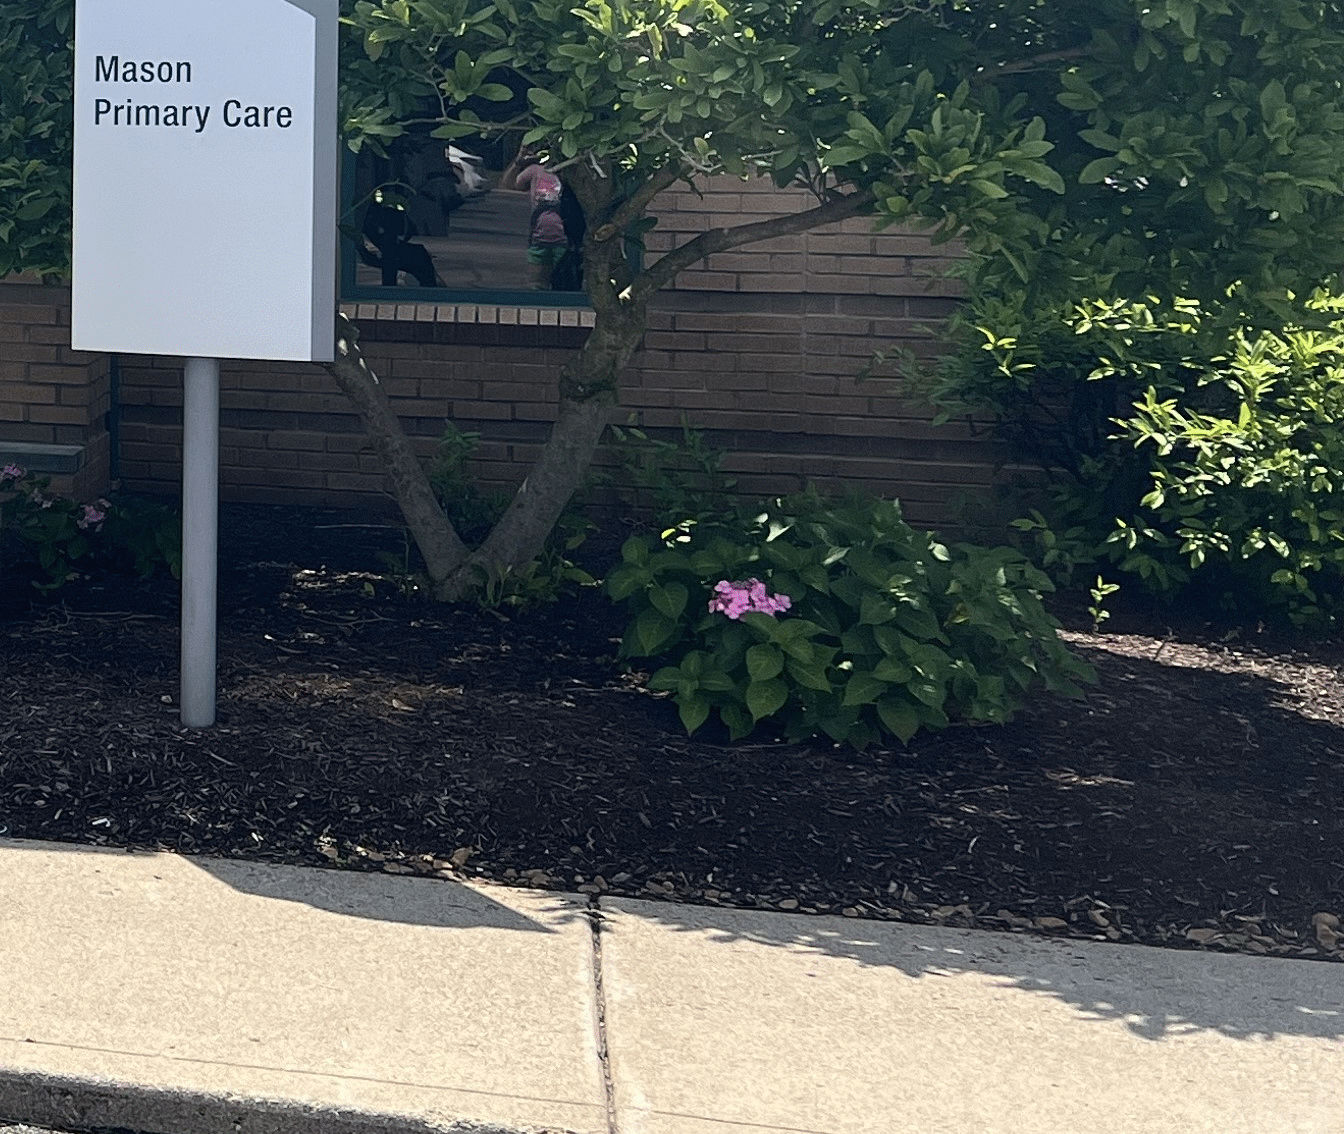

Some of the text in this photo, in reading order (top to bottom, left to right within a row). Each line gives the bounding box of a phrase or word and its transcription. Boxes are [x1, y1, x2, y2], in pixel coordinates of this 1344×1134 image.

[95, 55, 192, 83] Mason
[94, 98, 293, 133] Primary Care
